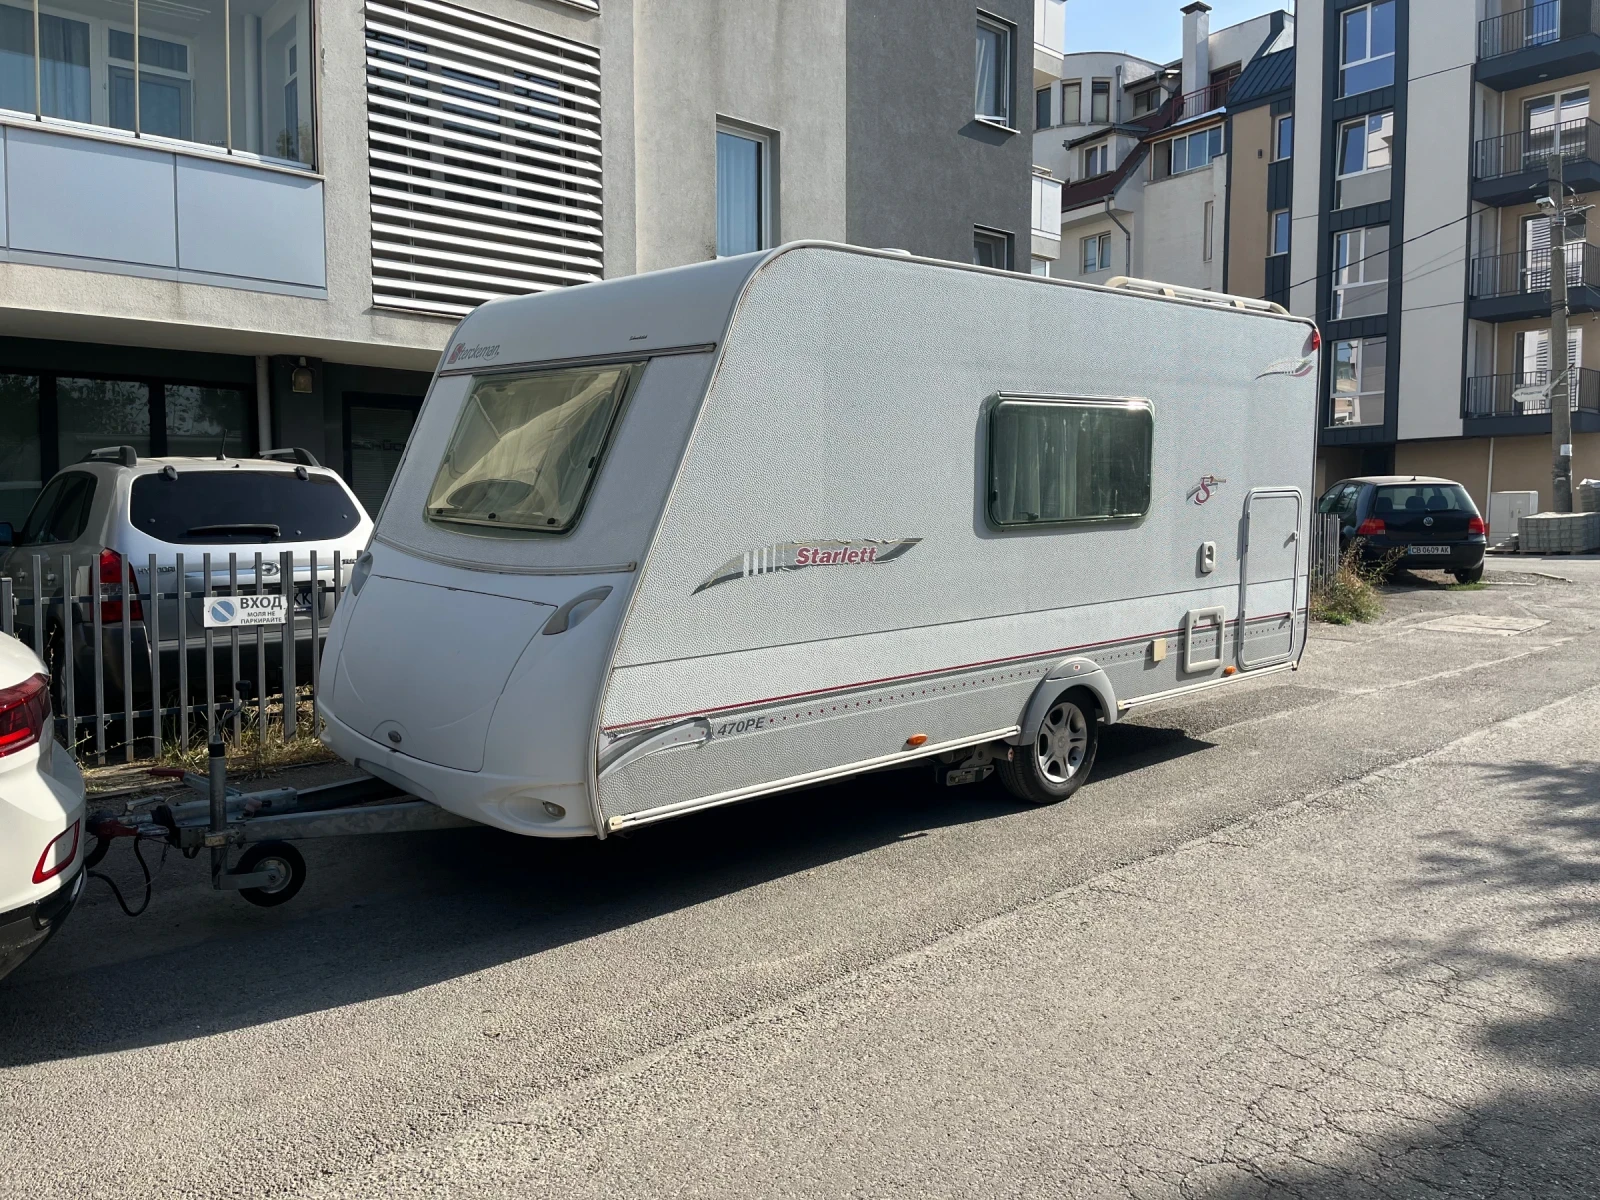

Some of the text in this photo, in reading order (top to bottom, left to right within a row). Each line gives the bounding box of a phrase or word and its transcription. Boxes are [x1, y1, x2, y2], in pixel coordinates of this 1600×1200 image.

[795, 546, 877, 565] Starlett
[1411, 546, 1449, 554] CB 0609 AK
[137, 566, 176, 574] HYNDAI
[240, 596, 283, 610] ВХОД
[717, 716, 765, 735] 470PE
